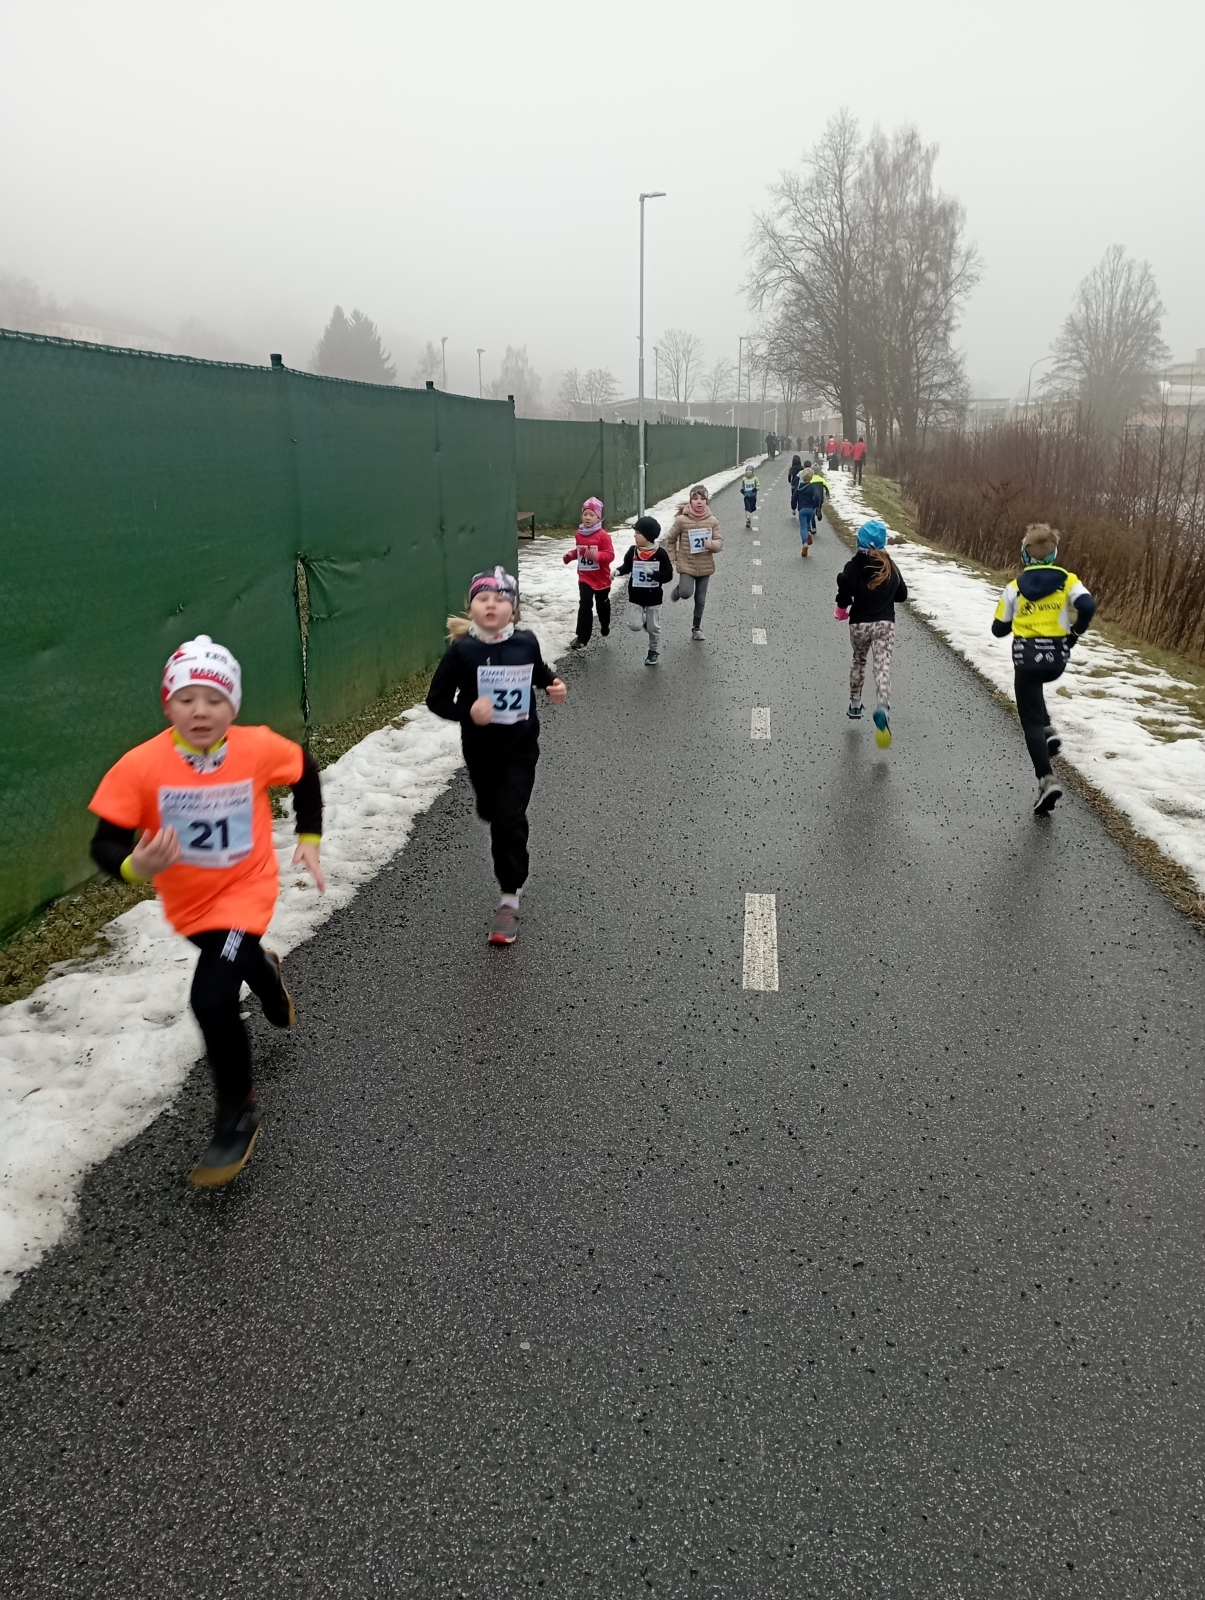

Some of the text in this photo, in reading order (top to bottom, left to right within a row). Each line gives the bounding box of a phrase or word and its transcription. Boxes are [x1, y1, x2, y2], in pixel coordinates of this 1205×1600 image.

[694, 537, 708, 548] 21
[639, 571, 653, 582] 55
[492, 688, 523, 712] 32
[187, 816, 230, 851] 21
